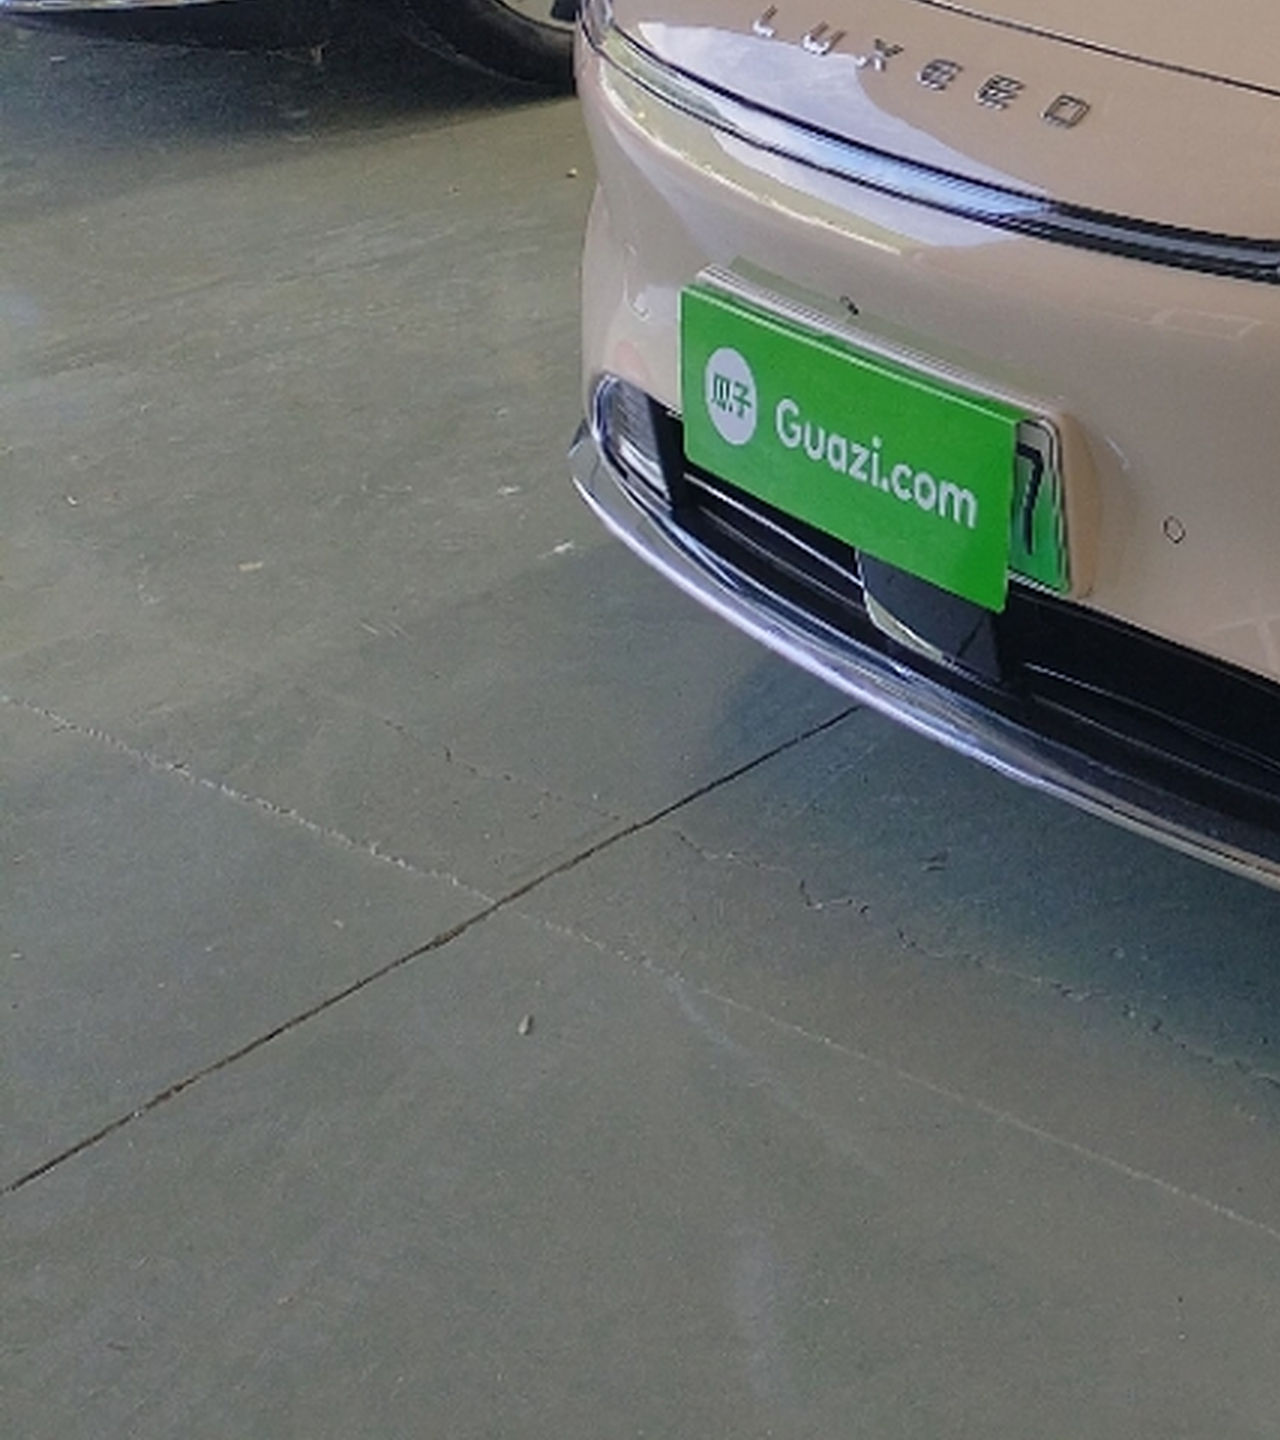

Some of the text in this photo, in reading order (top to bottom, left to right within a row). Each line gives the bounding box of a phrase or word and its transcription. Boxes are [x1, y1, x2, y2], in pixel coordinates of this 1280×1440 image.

[752, 5, 1091, 128] LUXEED
[711, 371, 752, 419] 瓜子
[775, 399, 979, 529] Guazi.com
